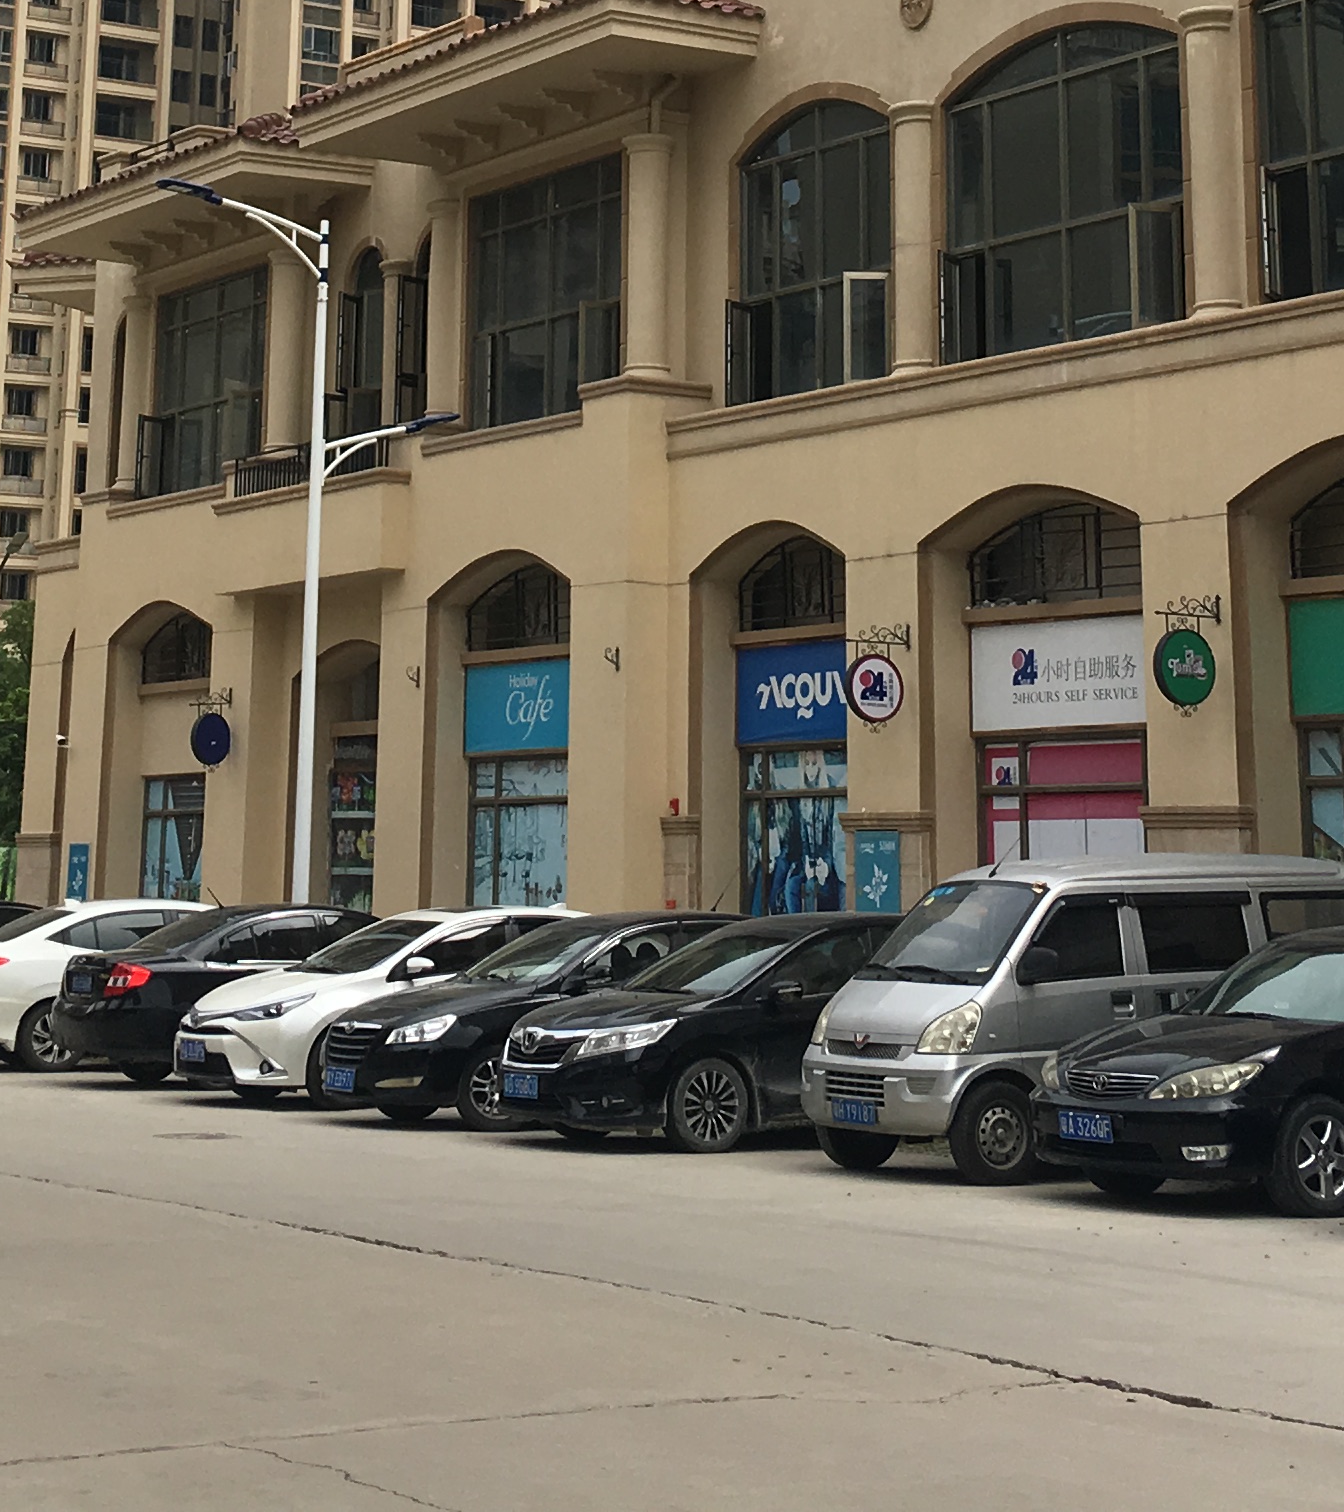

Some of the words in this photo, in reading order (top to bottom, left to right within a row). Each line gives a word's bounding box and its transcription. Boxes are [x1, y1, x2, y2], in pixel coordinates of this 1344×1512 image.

[1040, 653, 1137, 683] 小时自助服务
[505, 674, 555, 742] Café
[1012, 690, 1060, 705] 24HOURS
[1064, 688, 1089, 702] SELF
[1093, 686, 1139, 701] SERVICE
